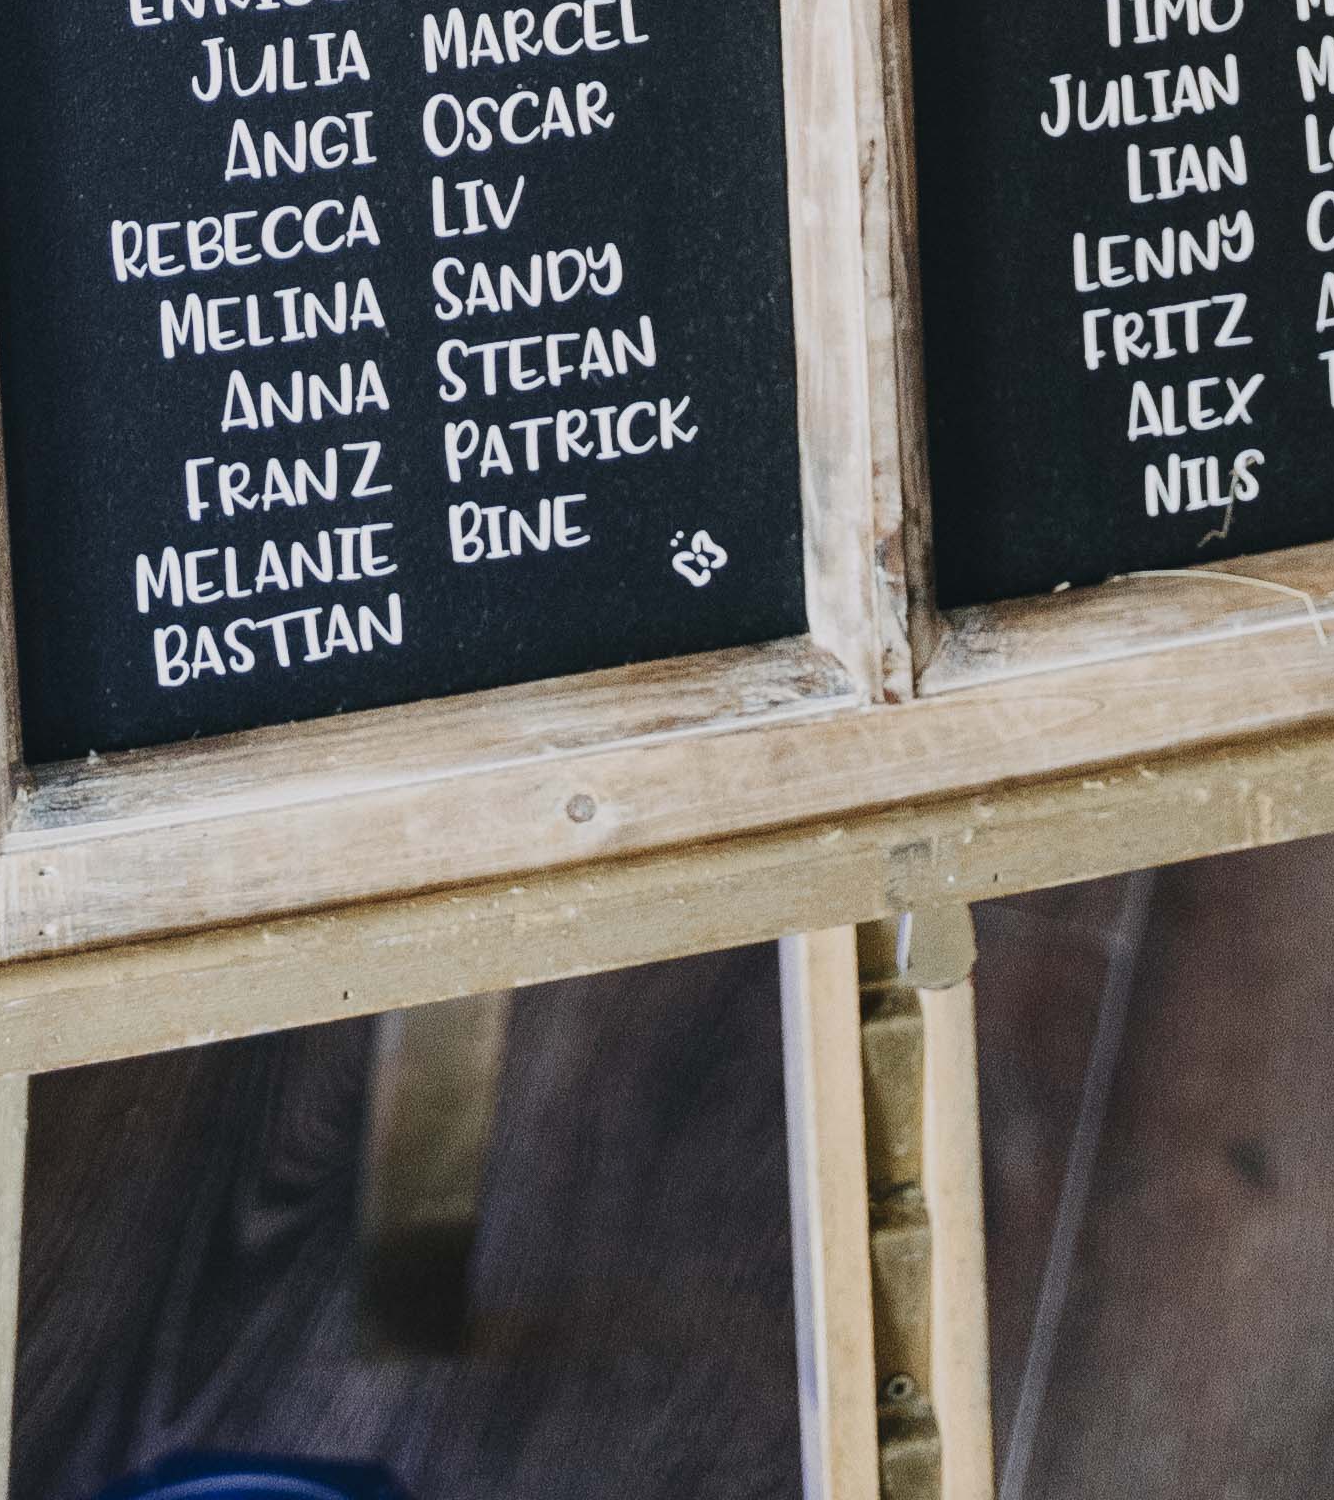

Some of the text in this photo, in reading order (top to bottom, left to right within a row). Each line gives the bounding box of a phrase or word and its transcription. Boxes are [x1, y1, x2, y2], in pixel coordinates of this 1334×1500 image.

[190, 28, 372, 103] JULIA
[1039, 52, 1240, 139] JULIAN
[223, 79, 616, 183] ANGI OSCAR
[1126, 133, 1249, 205] LIAN
[109, 174, 526, 284] REBECCA LIV
[1072, 208, 1256, 294] LENNY
[159, 241, 624, 360] MELINA SANDY
[1081, 291, 1254, 372] FRITZ
[219, 314, 658, 434] ANNA STEFAN
[1126, 372, 1266, 443] ALEX
[184, 394, 700, 523] FRANZ PATRICK
[1143, 447, 1266, 518] NILS
[134, 492, 592, 615] MELANIE BINE
[152, 591, 404, 688] BASTIAN
